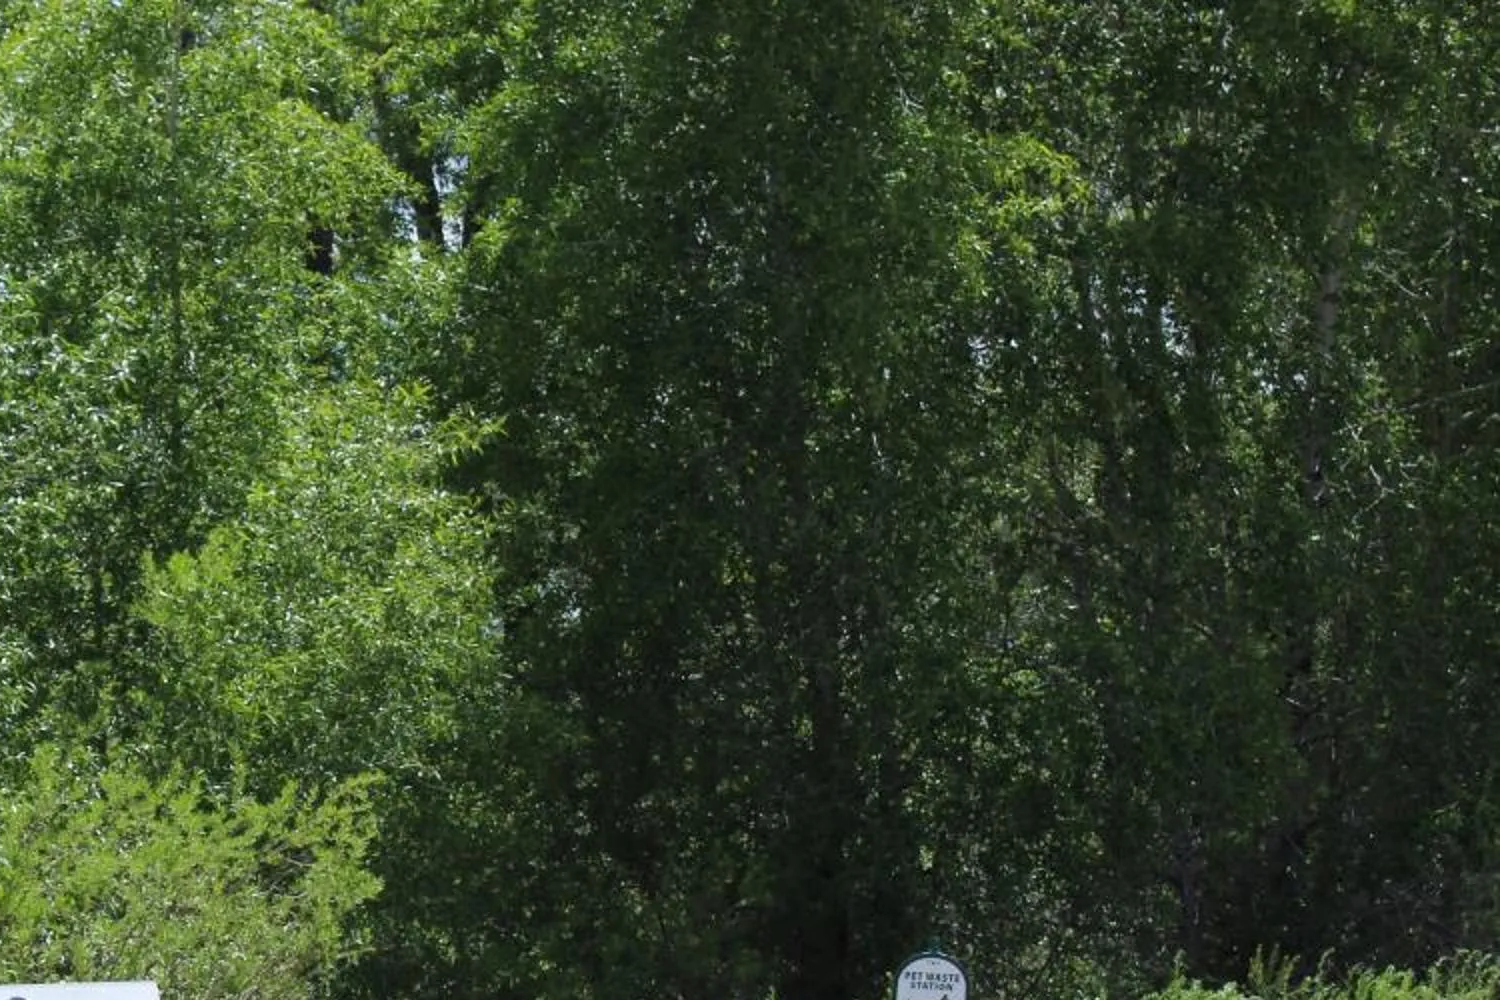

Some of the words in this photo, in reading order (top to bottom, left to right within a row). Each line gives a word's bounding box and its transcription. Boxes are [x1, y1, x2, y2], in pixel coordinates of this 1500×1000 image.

[904, 971, 923, 980] PET
[925, 972, 960, 983] WASTE
[910, 981, 954, 991] STATION
